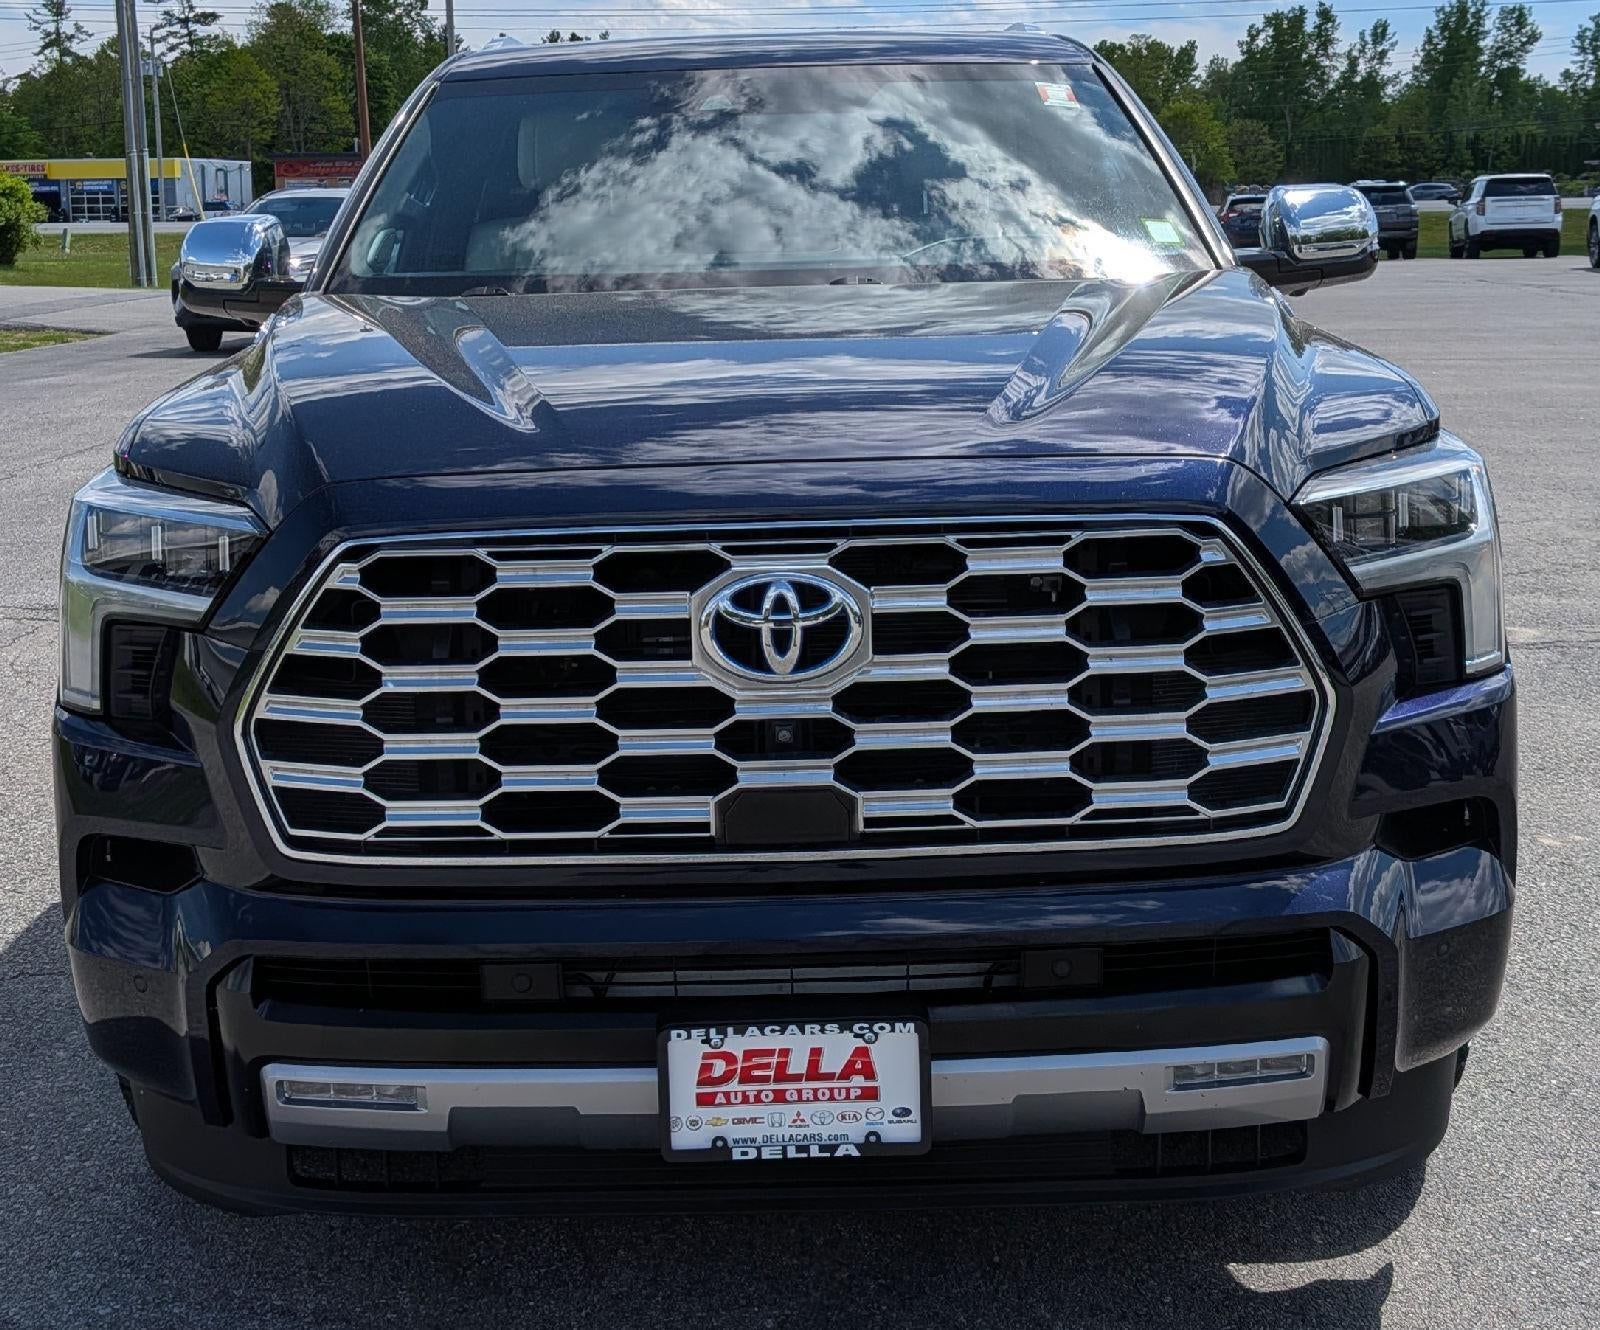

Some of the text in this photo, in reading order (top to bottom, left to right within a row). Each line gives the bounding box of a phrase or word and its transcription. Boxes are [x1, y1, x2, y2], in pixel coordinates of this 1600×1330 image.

[670, 1022, 916, 1041] DELLACARS.COM
[696, 1045, 879, 1089] DELLA
[714, 1088, 862, 1105] AUTO GROUP
[732, 1116, 766, 1125] GMC
[732, 1132, 850, 1145] www.DELLACARS.com
[732, 1144, 862, 1161] DELLA
